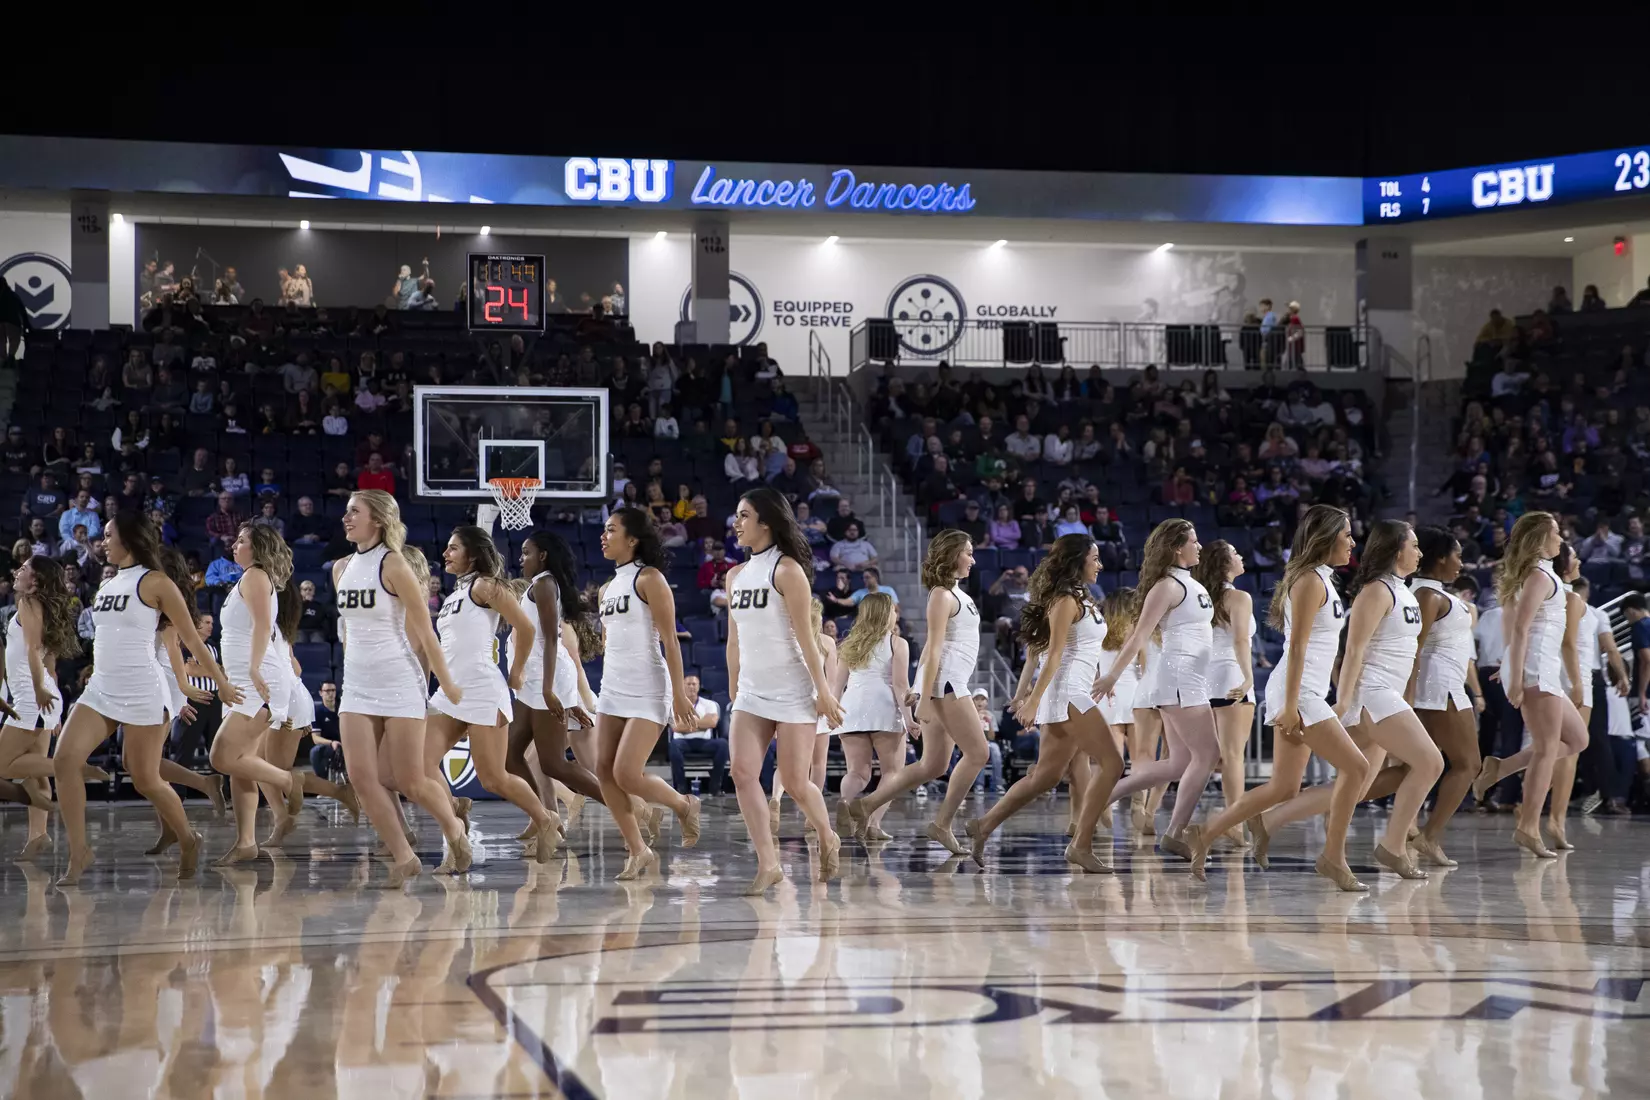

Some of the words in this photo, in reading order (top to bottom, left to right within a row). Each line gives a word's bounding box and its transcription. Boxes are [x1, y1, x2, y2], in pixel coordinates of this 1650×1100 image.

[1614, 151, 1650, 191] 23
[565, 157, 672, 202] CBU
[691, 166, 815, 208] Lancer
[825, 168, 976, 211] Dancers
[1379, 181, 1402, 197] TOL
[1421, 176, 1431, 193] 4
[1472, 163, 1555, 208] CBU
[1380, 202, 1401, 217] FLS
[1422, 198, 1430, 215] 7
[484, 286, 529, 322] 24
[773, 300, 853, 314] EQUIPPED
[976, 305, 1057, 317] GLOBALLY
[774, 315, 795, 326] TO
[800, 315, 850, 327] SERVE
[337, 588, 376, 609] CBU
[439, 598, 464, 618] BU
[730, 588, 769, 609] CBU
